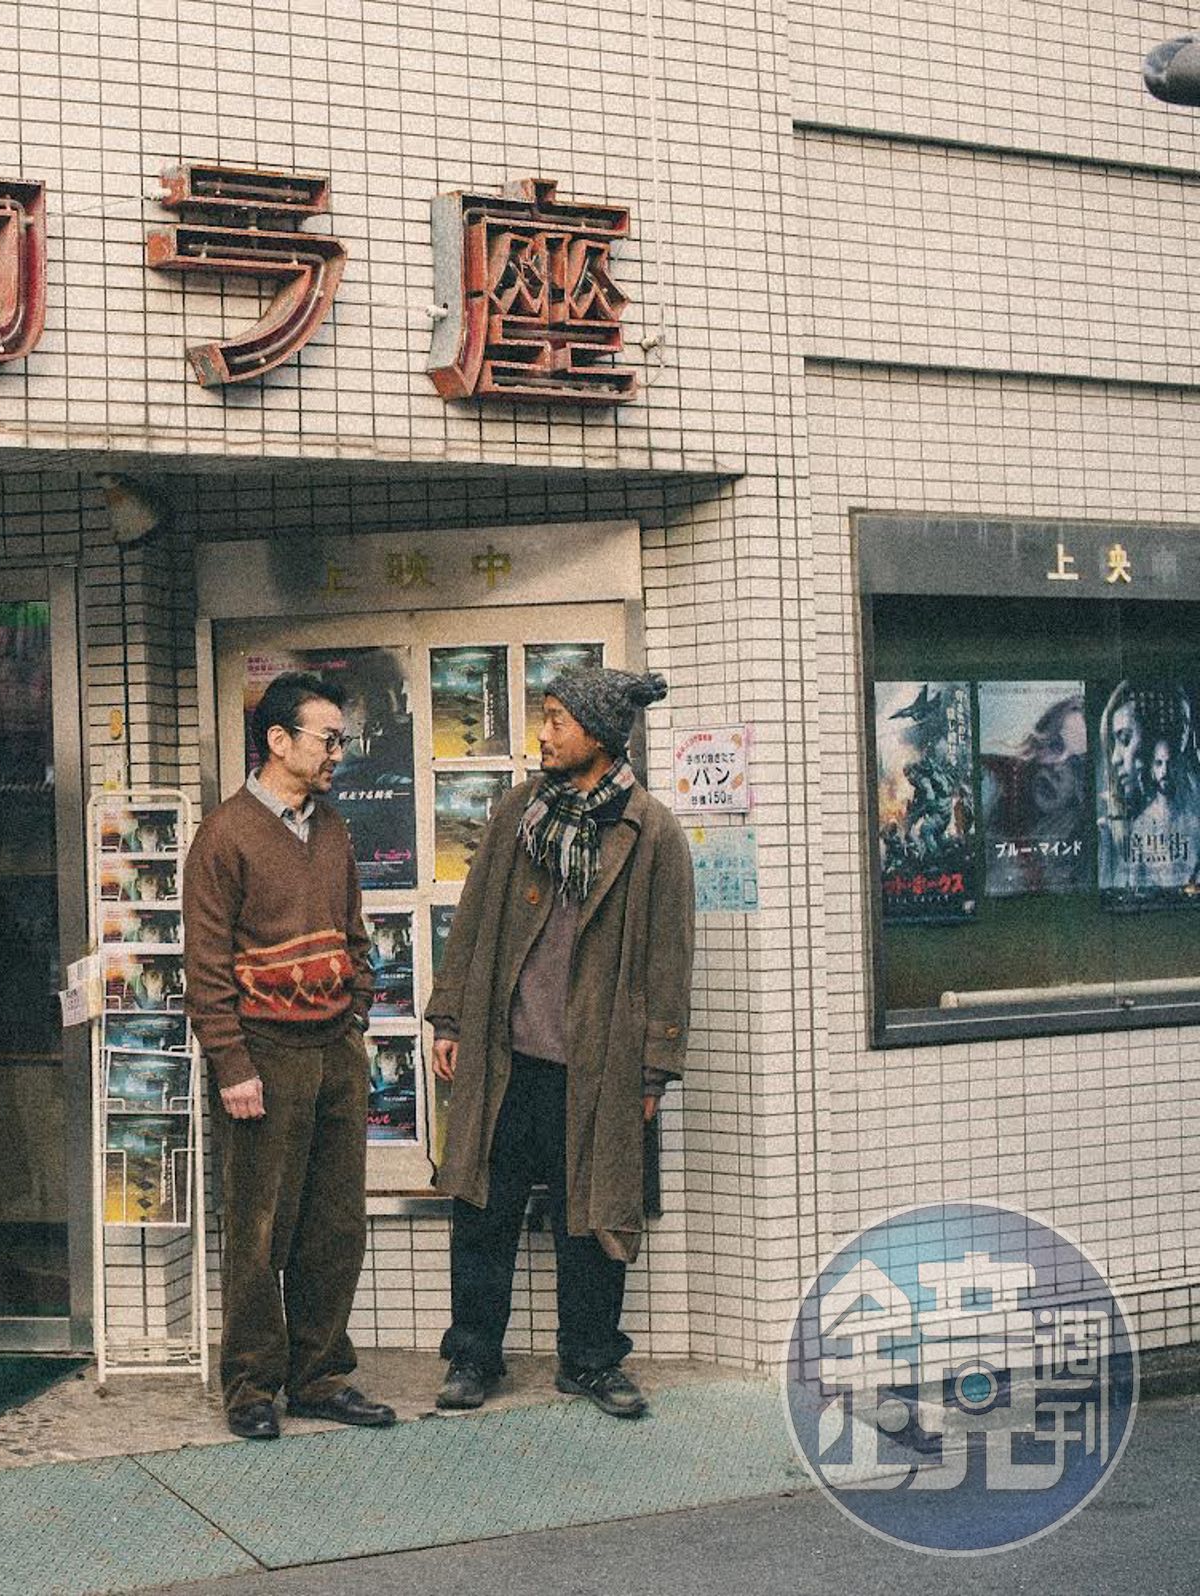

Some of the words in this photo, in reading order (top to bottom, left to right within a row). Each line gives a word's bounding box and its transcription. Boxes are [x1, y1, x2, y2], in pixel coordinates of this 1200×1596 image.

[320, 545, 513, 597] 上映中
[692, 767, 730, 786] パン
[994, 840, 1083, 858] ブルー・マインド
